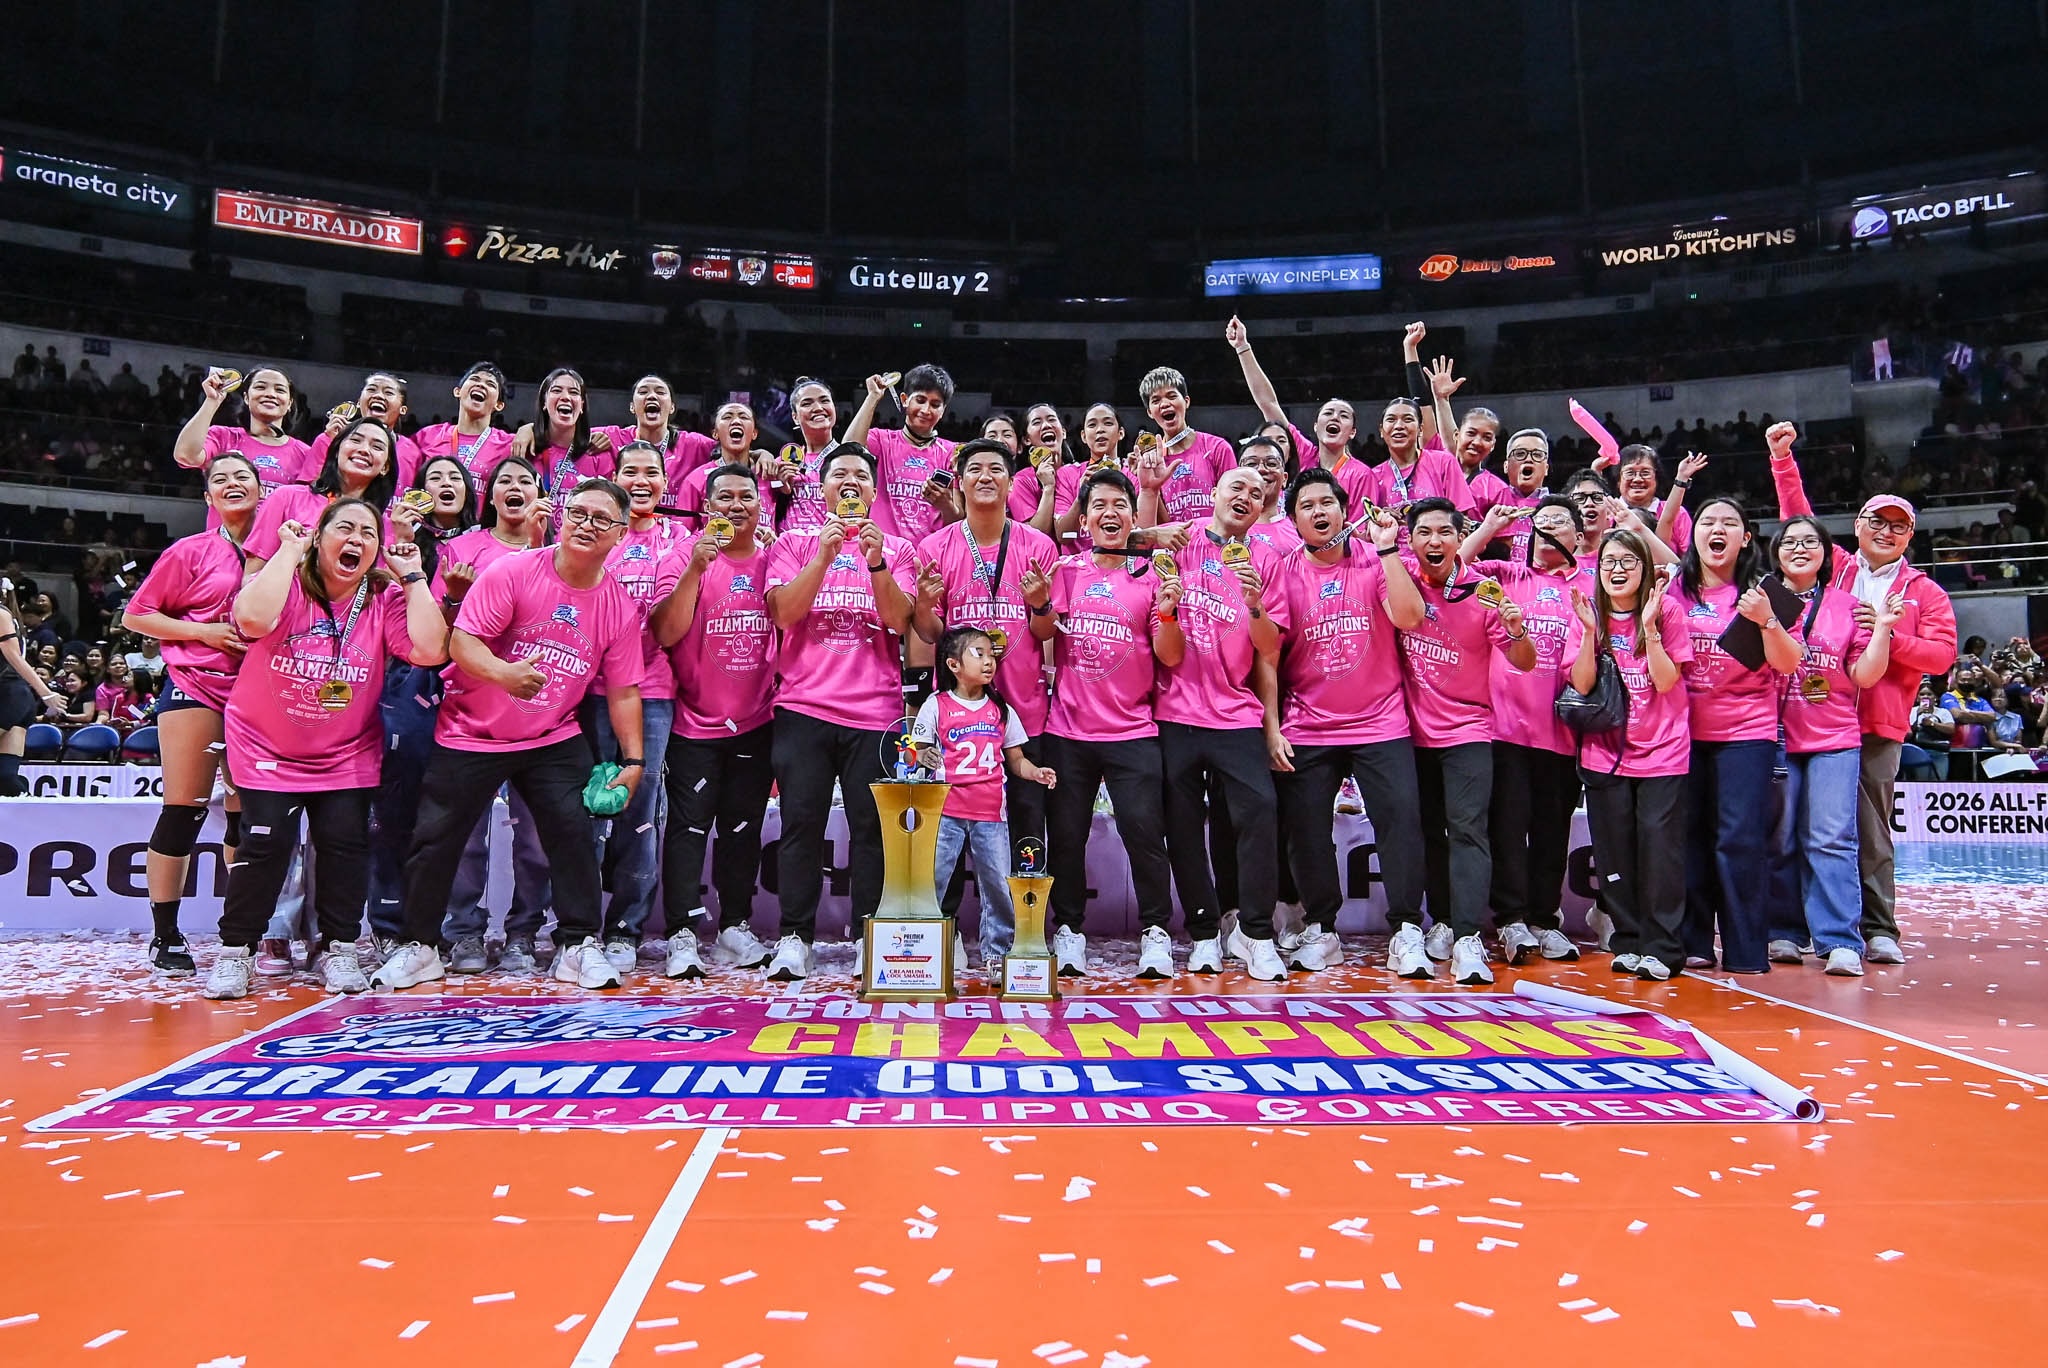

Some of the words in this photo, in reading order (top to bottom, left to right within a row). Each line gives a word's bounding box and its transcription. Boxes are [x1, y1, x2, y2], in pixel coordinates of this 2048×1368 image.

[16, 164, 118, 197] araneta
[126, 183, 178, 211] city
[234, 201, 403, 244] EMPERADOR
[1892, 202, 1950, 225] TACO
[476, 230, 562, 264] Pizza
[564, 241, 627, 271] Hut
[1601, 243, 1681, 267] WORLD
[692, 266, 728, 280] Cignal
[776, 272, 811, 285] Cignal
[1206, 272, 1280, 286] GATEWAY
[1284, 268, 1359, 283] CINEPLEX
[1363, 267, 1381, 280] 18
[1426, 260, 1452, 274] DQ
[974, 272, 989, 292] 2
[812, 591, 877, 611] HAMPION
[953, 603, 1026, 621] CHAMPIONS
[706, 616, 772, 635] CHAMPION
[1067, 618, 1134, 643] HAMPIONS
[511, 640, 591, 675] CHAMPIONS
[1402, 635, 1459, 665] AMPIONS
[270, 654, 369, 682] CHAMPIONS
[949, 721, 996, 741] Creamline
[955, 741, 998, 774] 24
[1925, 792, 1986, 812] 2026
[275, 1023, 730, 1057] Smashers
[747, 1019, 1685, 1058] CHAMPIONS
[172, 1064, 833, 1097] CREAMLINE
[1178, 1061, 1751, 1094] SMASHERS
[125, 1104, 375, 1123] 2026
[638, 1102, 799, 1121] ALL
[844, 1101, 1229, 1121] FILIPINO
